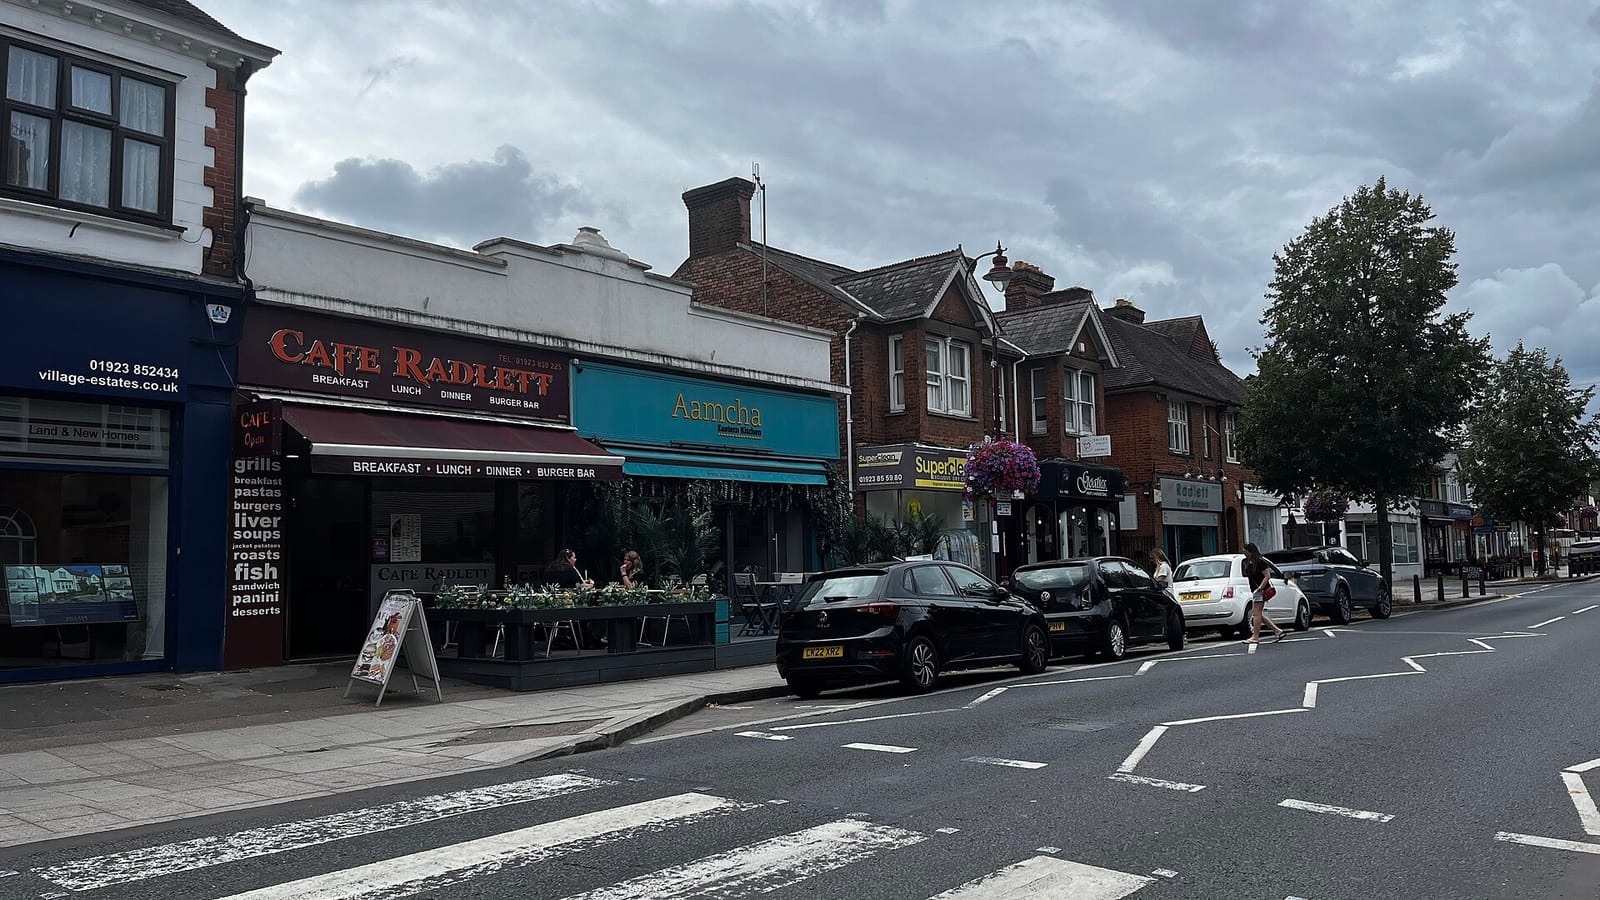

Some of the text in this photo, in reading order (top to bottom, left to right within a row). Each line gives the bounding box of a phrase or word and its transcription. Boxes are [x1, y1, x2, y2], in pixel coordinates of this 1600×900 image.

[90, 359, 179, 379] 01923 852434
[267, 328, 553, 397] CAFE RADLETT
[38, 370, 178, 393] village-estates.co.uk
[312, 374, 370, 389] BREAKFAST
[391, 384, 422, 395] LUNCH
[440, 390, 472, 402] DINNER
[489, 396, 540, 410] BURGER BAR
[672, 393, 762, 426] Aamcha
[241, 412, 270, 428] CAFE
[29, 424, 140, 441] Land & New Homes
[244, 432, 265, 448] Open
[234, 457, 281, 474] grills
[353, 461, 595, 478] BREAKFAST LUNCH DINNER BURGER BAR
[915, 456, 966, 480] Supercle
[234, 476, 282, 486] breakfast
[234, 487, 281, 499] pastas
[1176, 483, 1208, 498] Radlett
[234, 500, 282, 512] burgers
[234, 512, 281, 528] liver
[233, 529, 281, 541] soups
[233, 550, 280, 561] roasts
[234, 563, 278, 581] fish
[378, 567, 489, 582] CAFE RADLETT
[232, 582, 280, 591] sandwich
[232, 591, 280, 606] panini
[232, 605, 281, 616] desserts
